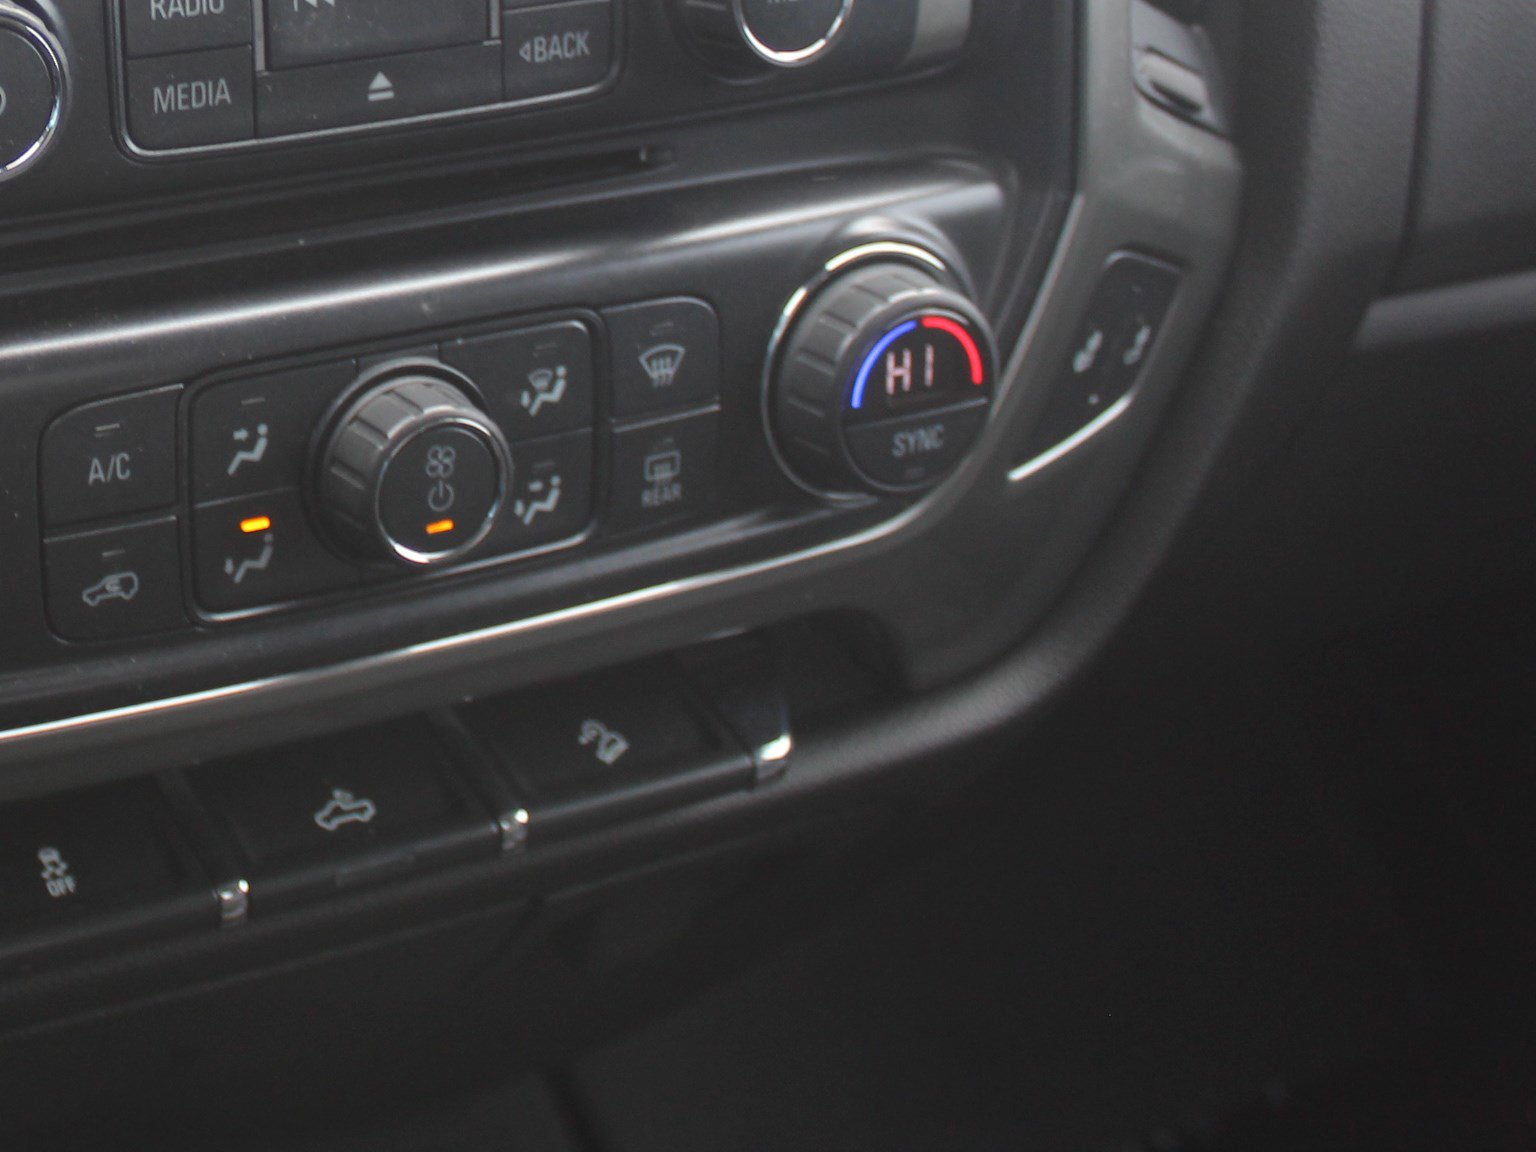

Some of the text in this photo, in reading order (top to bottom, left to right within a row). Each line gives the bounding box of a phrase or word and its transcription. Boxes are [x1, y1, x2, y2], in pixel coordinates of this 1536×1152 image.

[533, 32, 591, 64] BACK
[153, 79, 232, 114] MEDIA
[891, 424, 945, 458] SYNC
[88, 452, 131, 484] A/C
[641, 481, 683, 508] REAR
